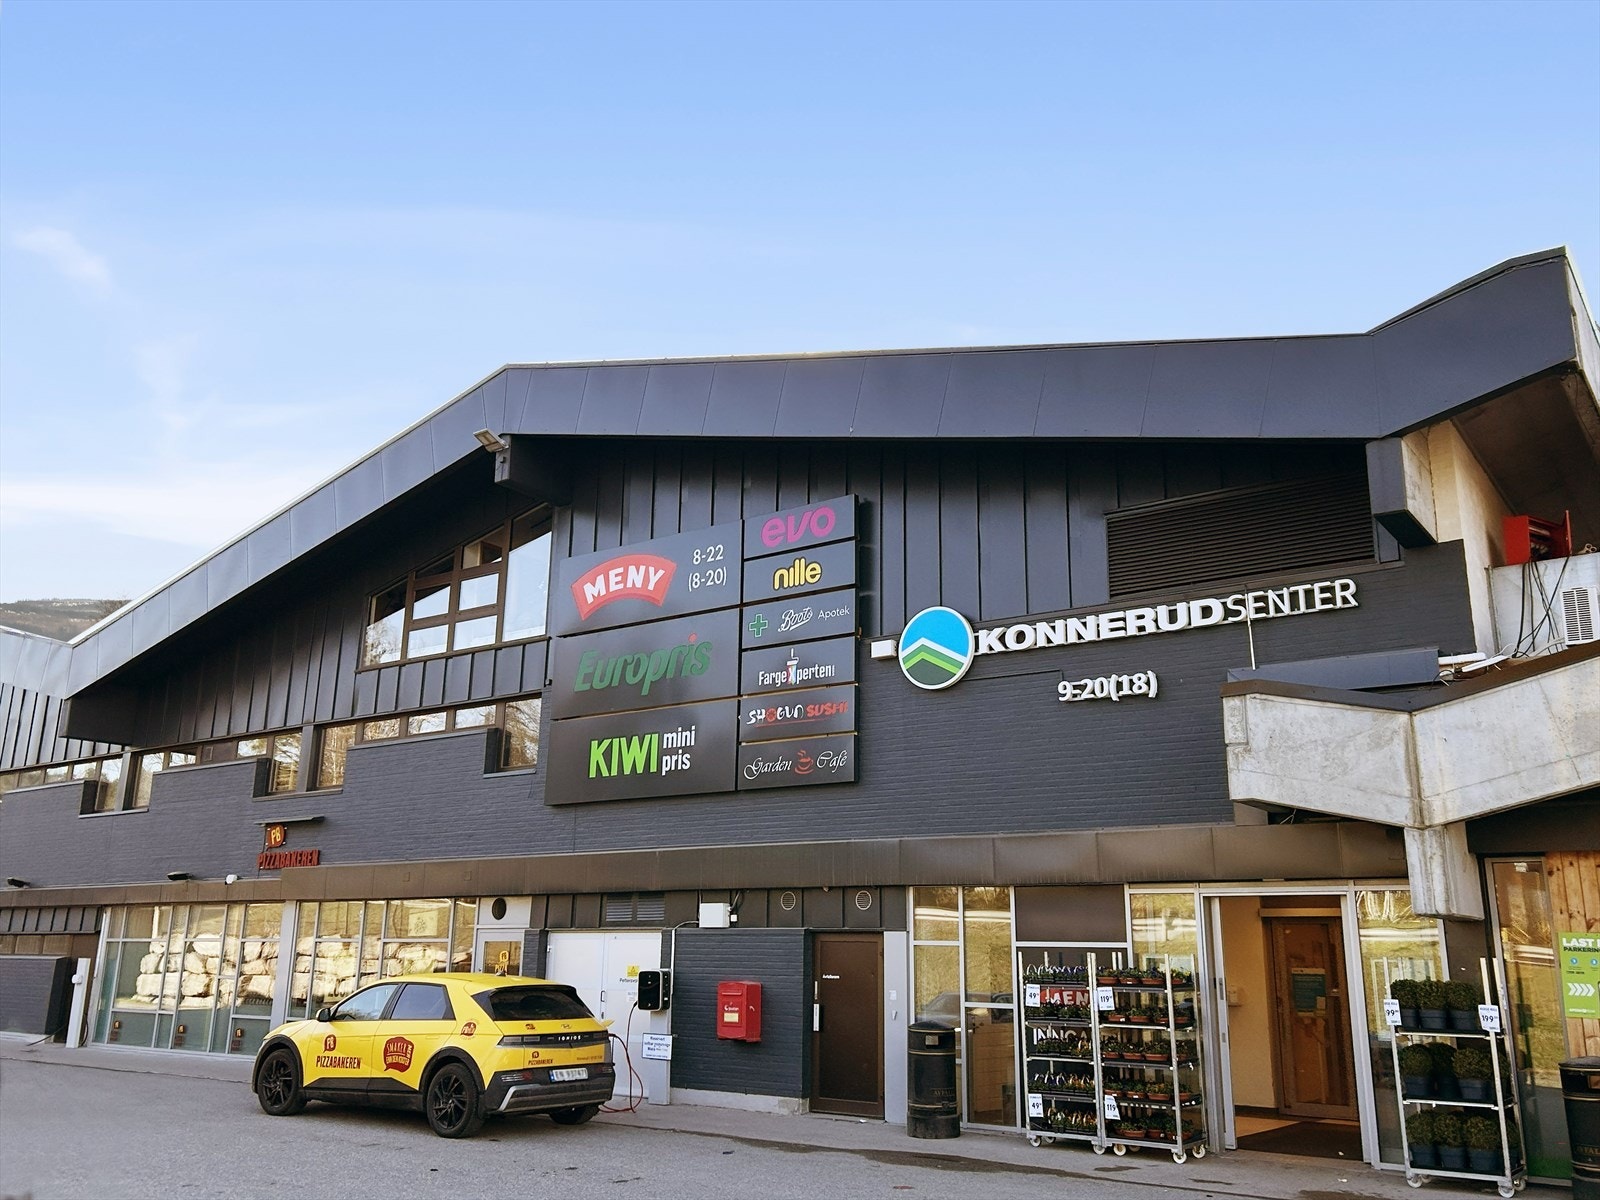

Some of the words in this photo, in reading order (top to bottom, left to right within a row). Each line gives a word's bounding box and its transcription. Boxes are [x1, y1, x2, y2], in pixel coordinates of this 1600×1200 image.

[761, 506, 836, 548] evo
[692, 544, 724, 566] 8-22
[582, 564, 666, 605] MENY
[687, 566, 728, 592] (8-20)
[773, 557, 822, 591] nille
[777, 606, 813, 632] Boots
[817, 605, 850, 621] Apotek
[573, 633, 714, 696] Europris
[758, 664, 832, 687] FargeXperten
[1057, 670, 1158, 702] 9-20(18)
[746, 704, 804, 725] SHOGUN
[806, 701, 849, 717] SUSHI
[588, 732, 660, 778] KIWI
[662, 725, 696, 749] mini
[661, 750, 691, 776] pris
[743, 755, 792, 780] Garden
[257, 849, 320, 870] PIZZABAKEREN
[1562, 937, 1595, 948] LAST
[316, 1055, 362, 1070] PIZZABAKEREN
